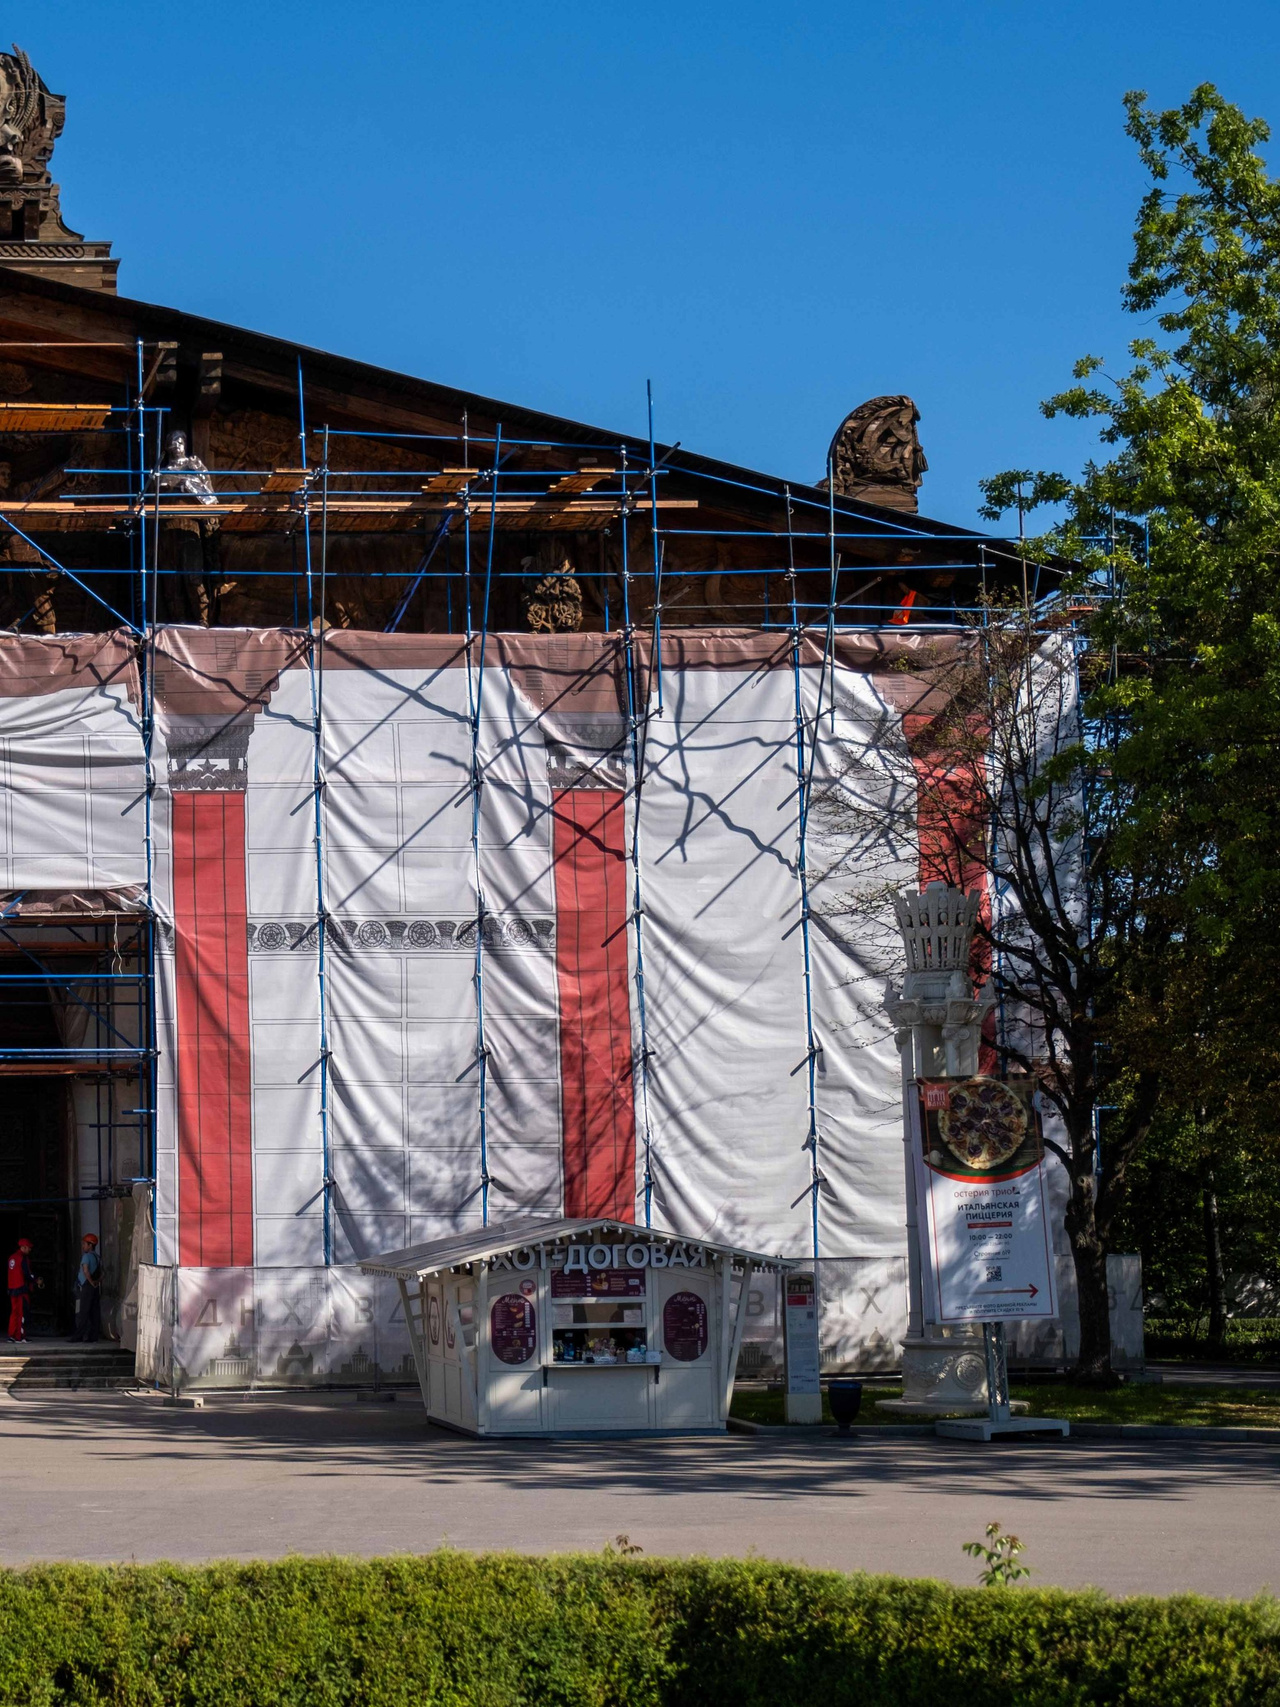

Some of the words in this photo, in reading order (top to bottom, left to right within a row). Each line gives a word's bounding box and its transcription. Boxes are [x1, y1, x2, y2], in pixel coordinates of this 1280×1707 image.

[954, 1190, 989, 1199] остерия
[991, 1188, 1013, 1198] трио
[958, 1201, 1019, 1211] ИТАЛЬЯНСКАЯ
[966, 1211, 1013, 1221] ПИЦЦЕРИЯ
[492, 1244, 706, 1275] ХОТ-ДОГОВАЯ
